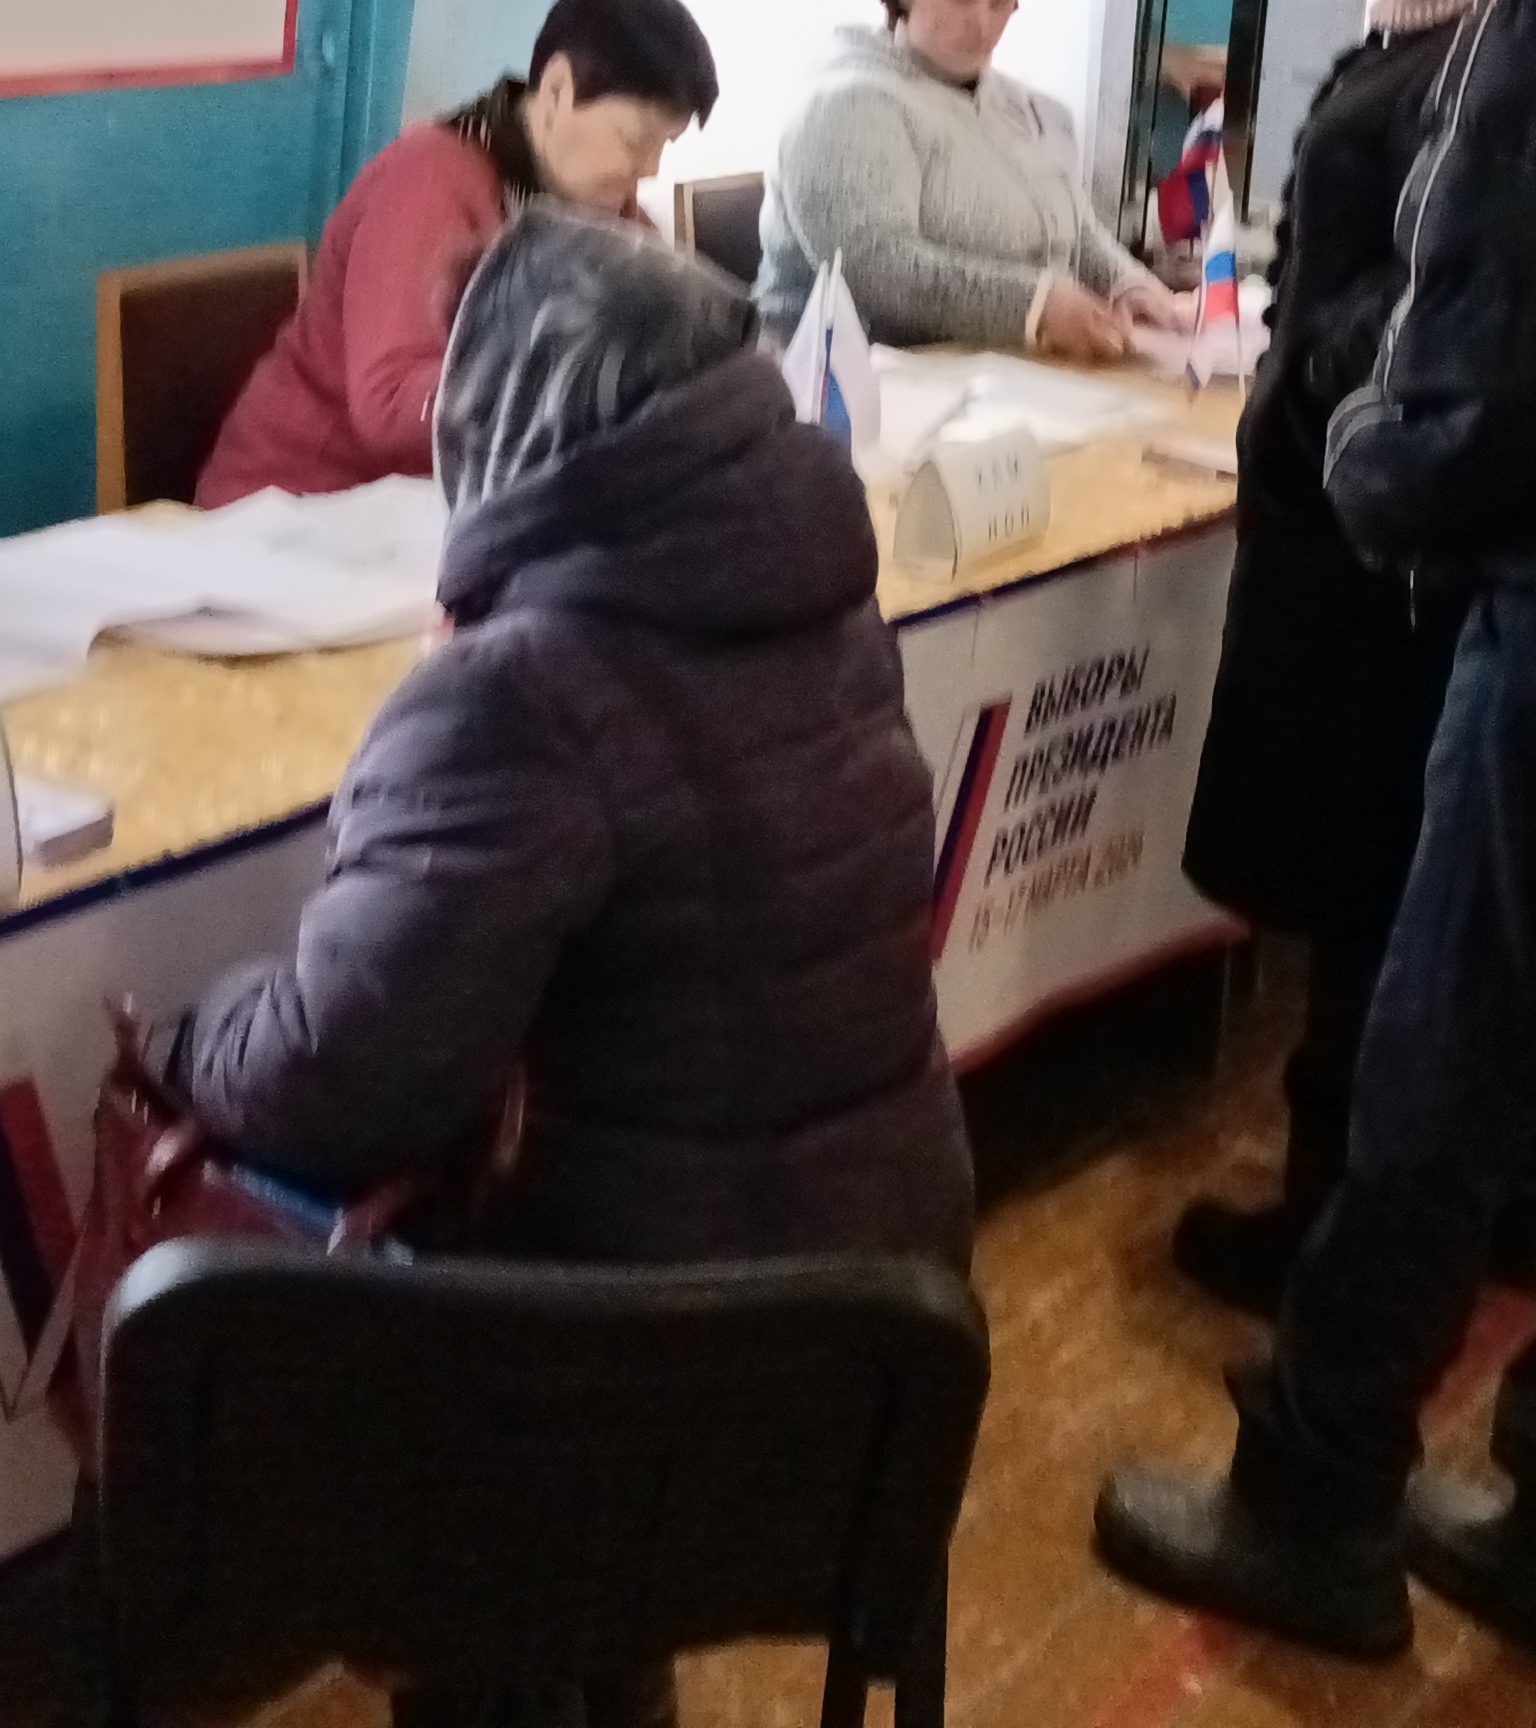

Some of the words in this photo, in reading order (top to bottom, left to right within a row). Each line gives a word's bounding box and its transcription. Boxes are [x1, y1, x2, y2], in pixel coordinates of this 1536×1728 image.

[1023, 641, 1151, 739] ВЫБОРЫ
[1003, 690, 1177, 814] ПРЕЗИДЕНТА
[983, 783, 1098, 889] РОССИИ
